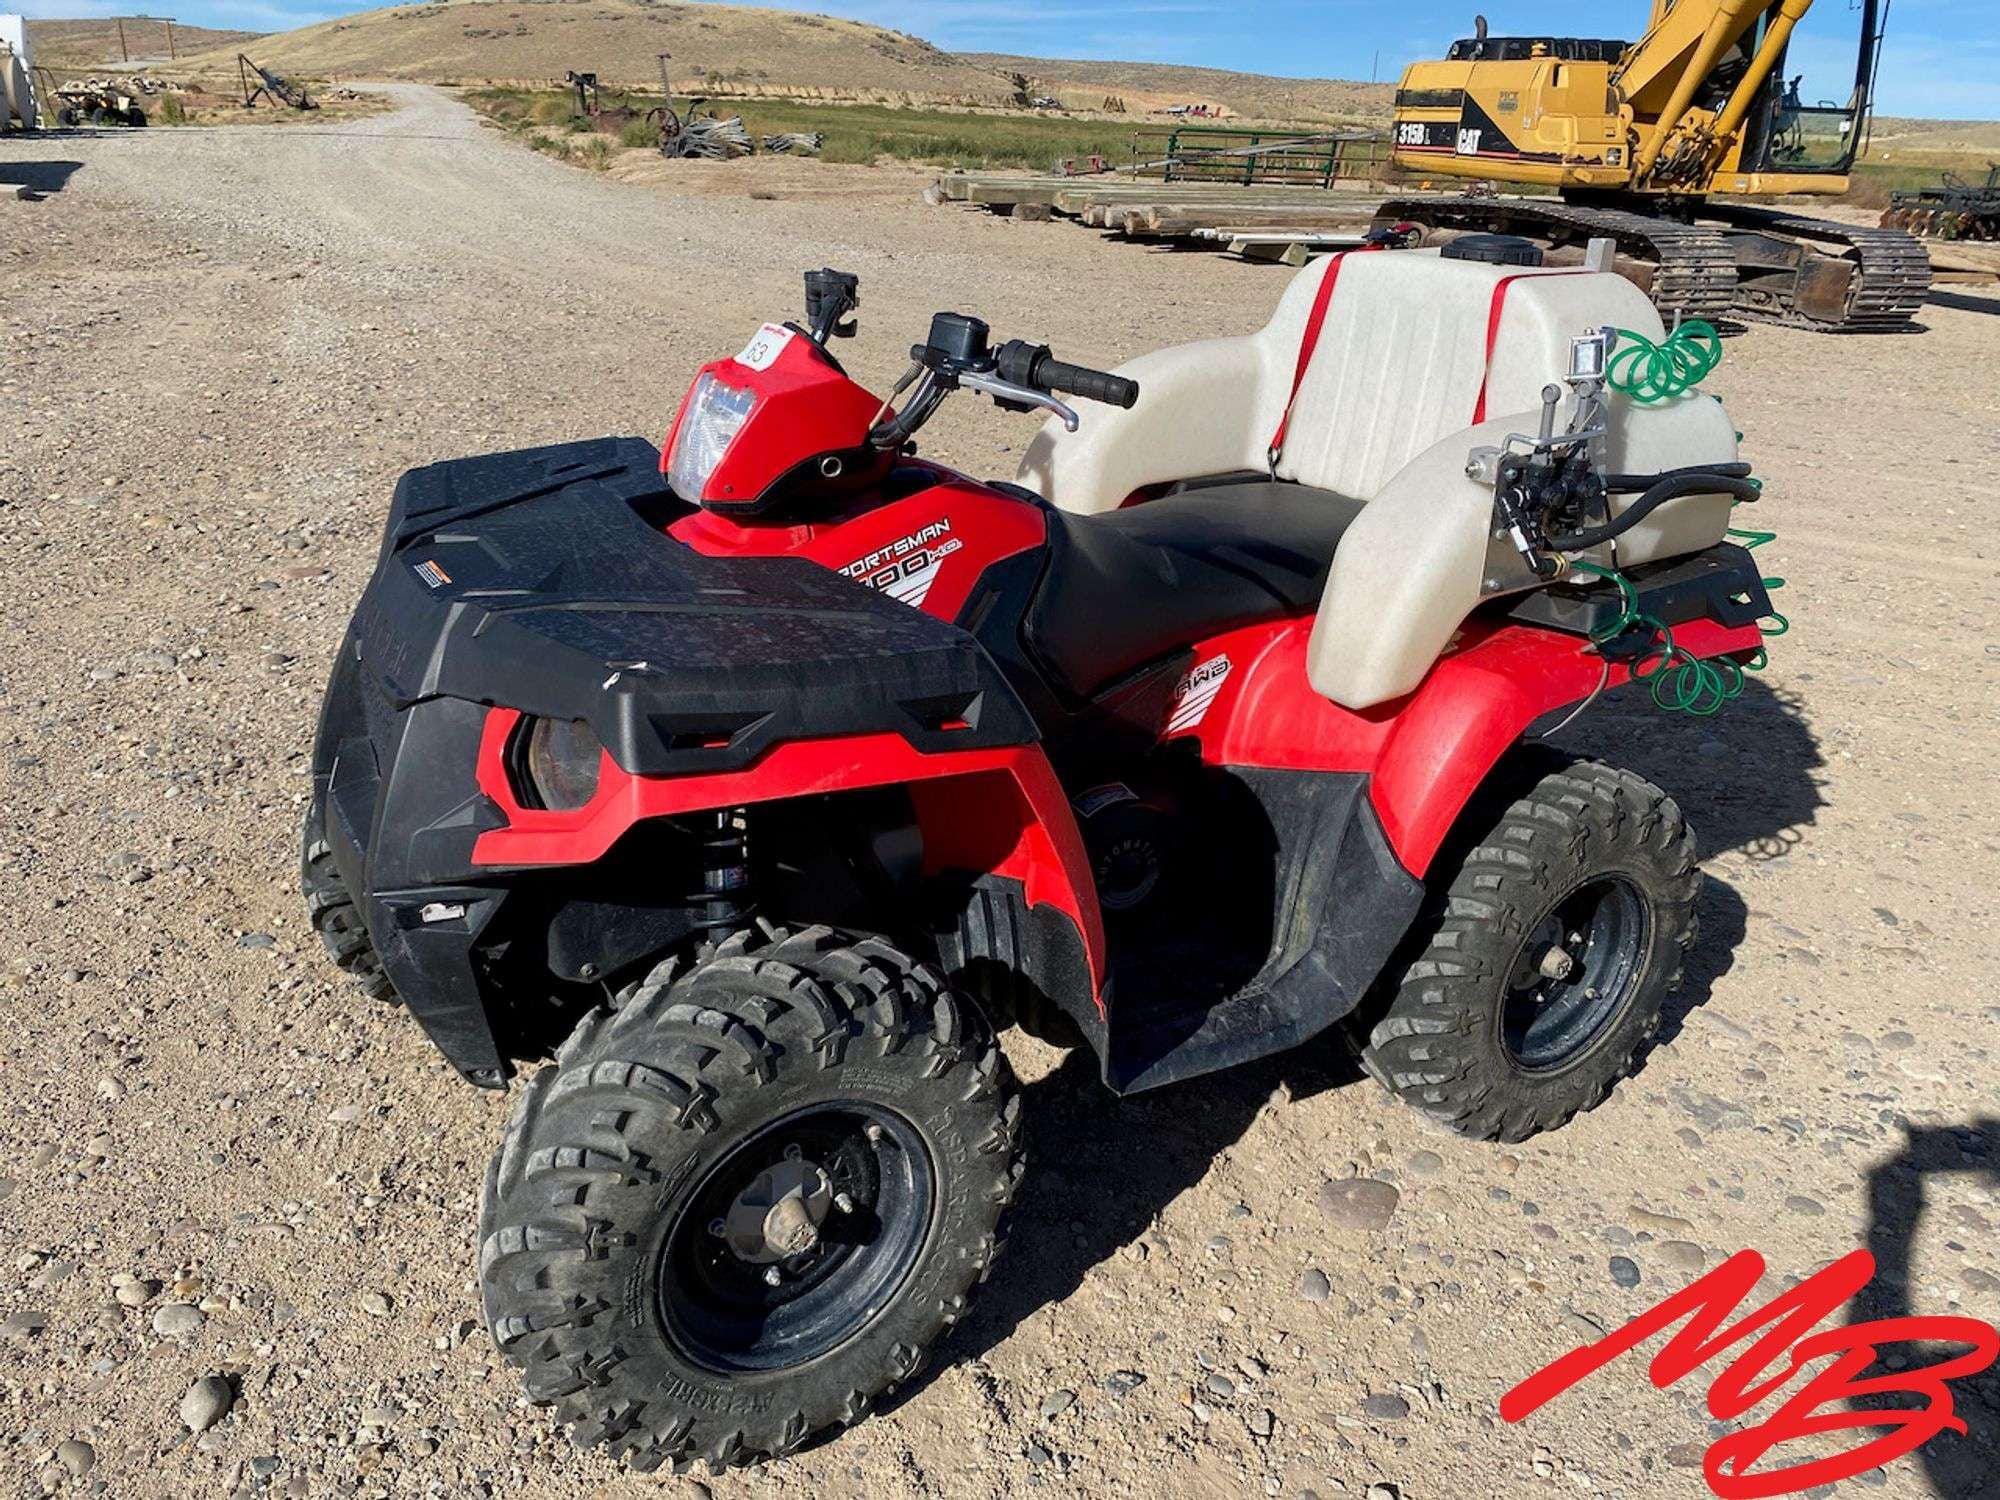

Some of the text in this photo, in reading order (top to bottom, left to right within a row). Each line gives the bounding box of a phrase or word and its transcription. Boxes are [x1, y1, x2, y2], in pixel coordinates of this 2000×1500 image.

[1398, 123, 1425, 145] 315B
[1457, 128, 1482, 155] CAT
[838, 517, 951, 577] PORTSMAN
[1174, 660, 1229, 699] AWD
